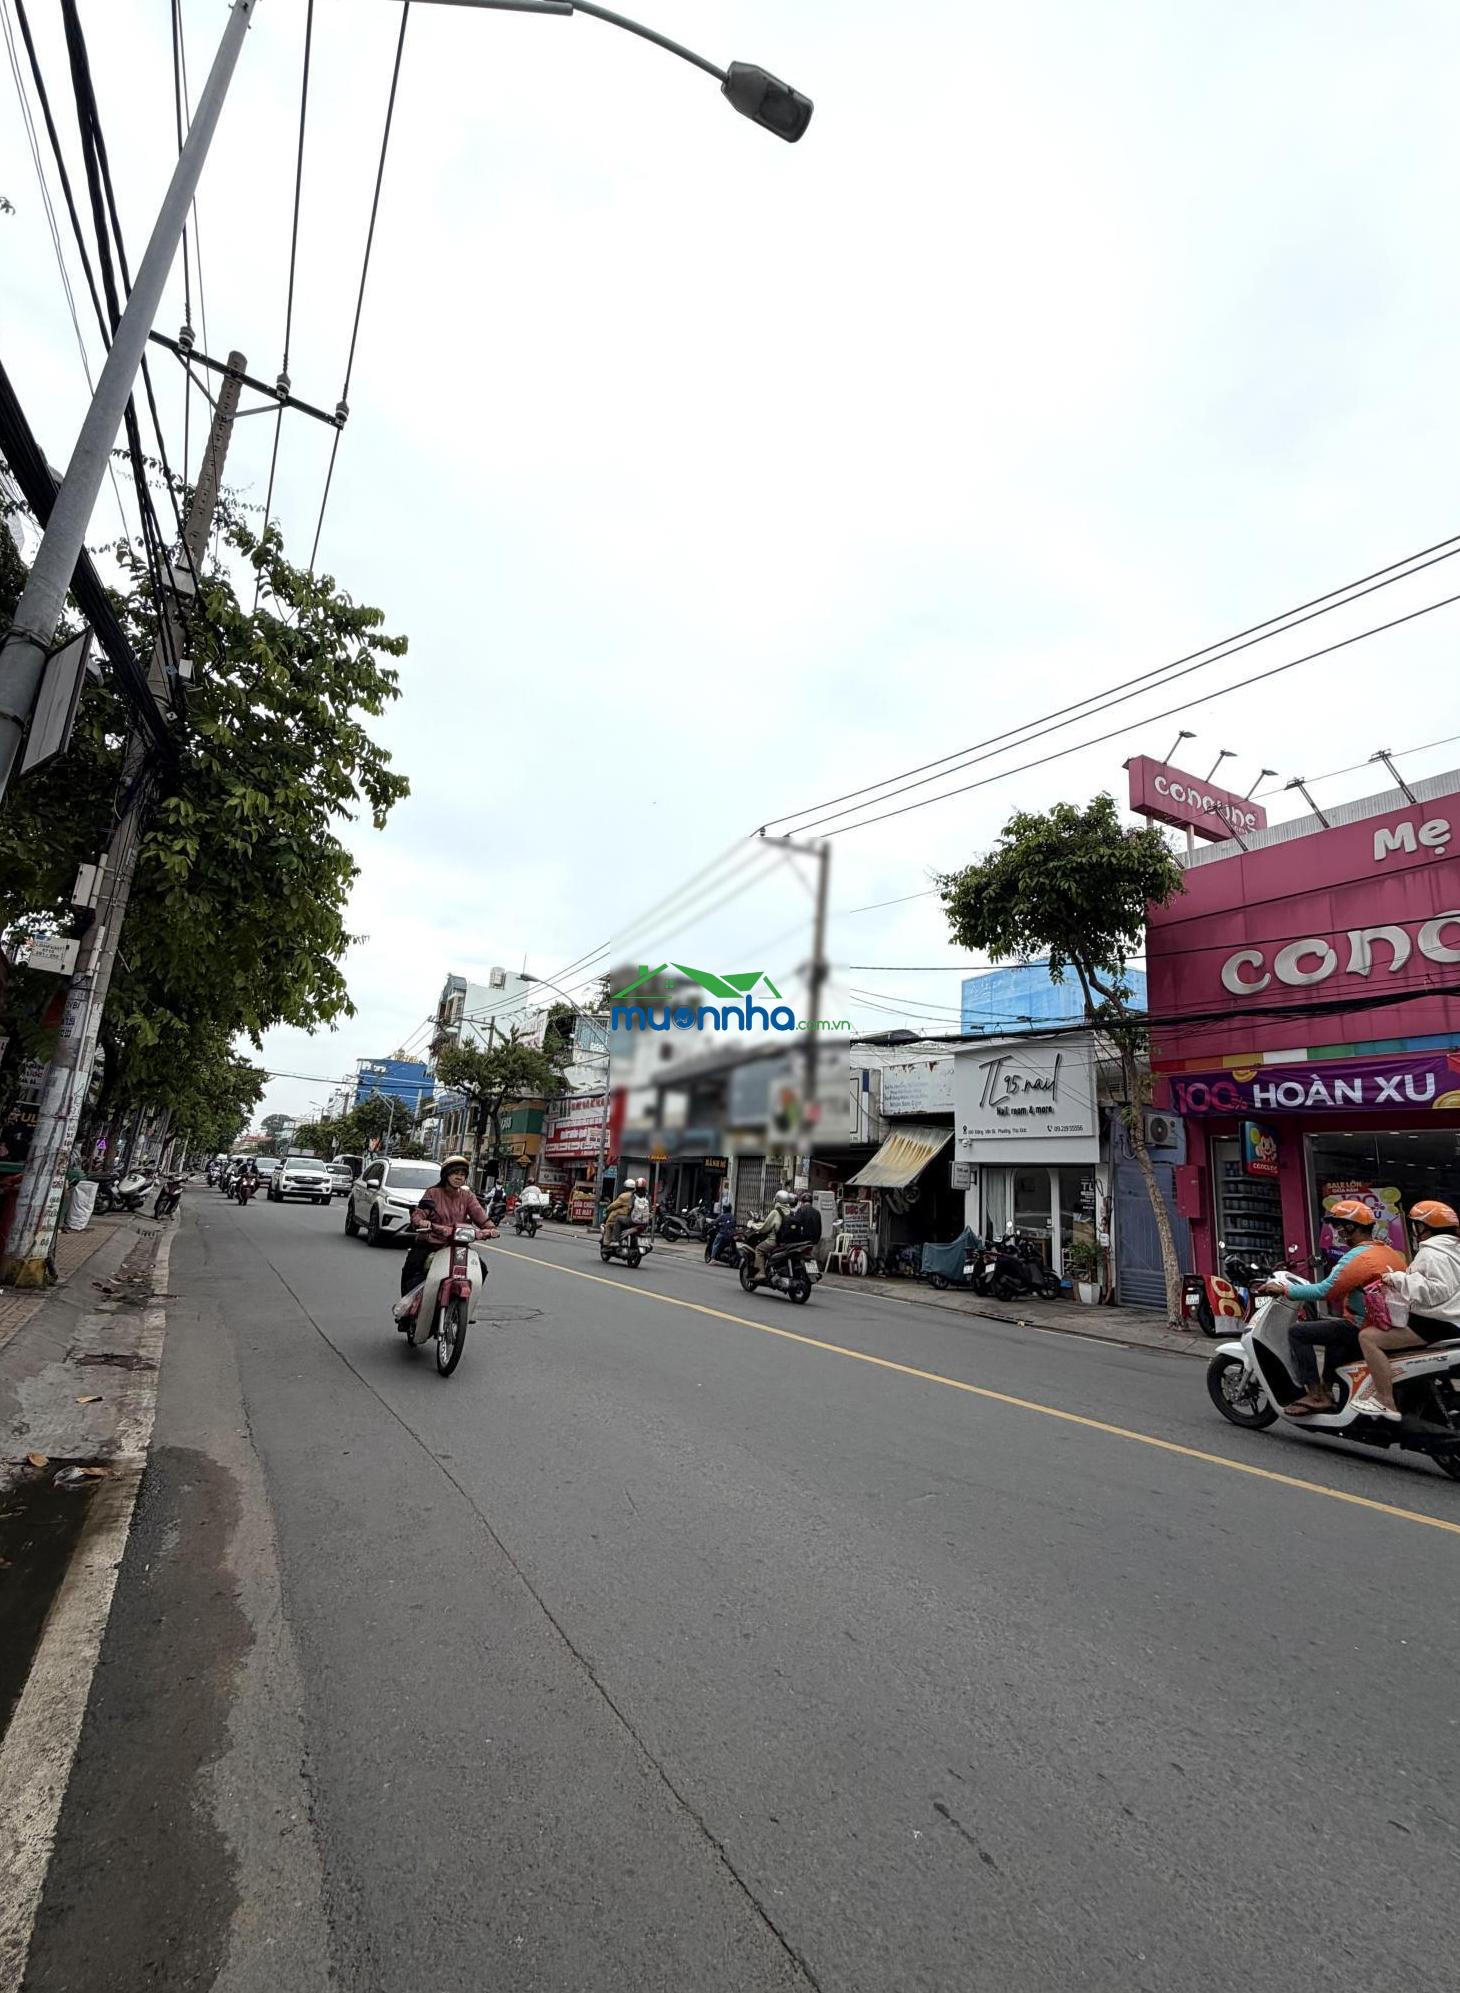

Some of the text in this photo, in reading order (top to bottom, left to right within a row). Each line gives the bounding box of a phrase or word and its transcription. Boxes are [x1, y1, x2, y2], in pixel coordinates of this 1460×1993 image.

[1374, 818, 1451, 861] Mẹ
[1253, 1074, 1362, 1108] HOÀN
[1374, 1073, 1435, 1103] XU
